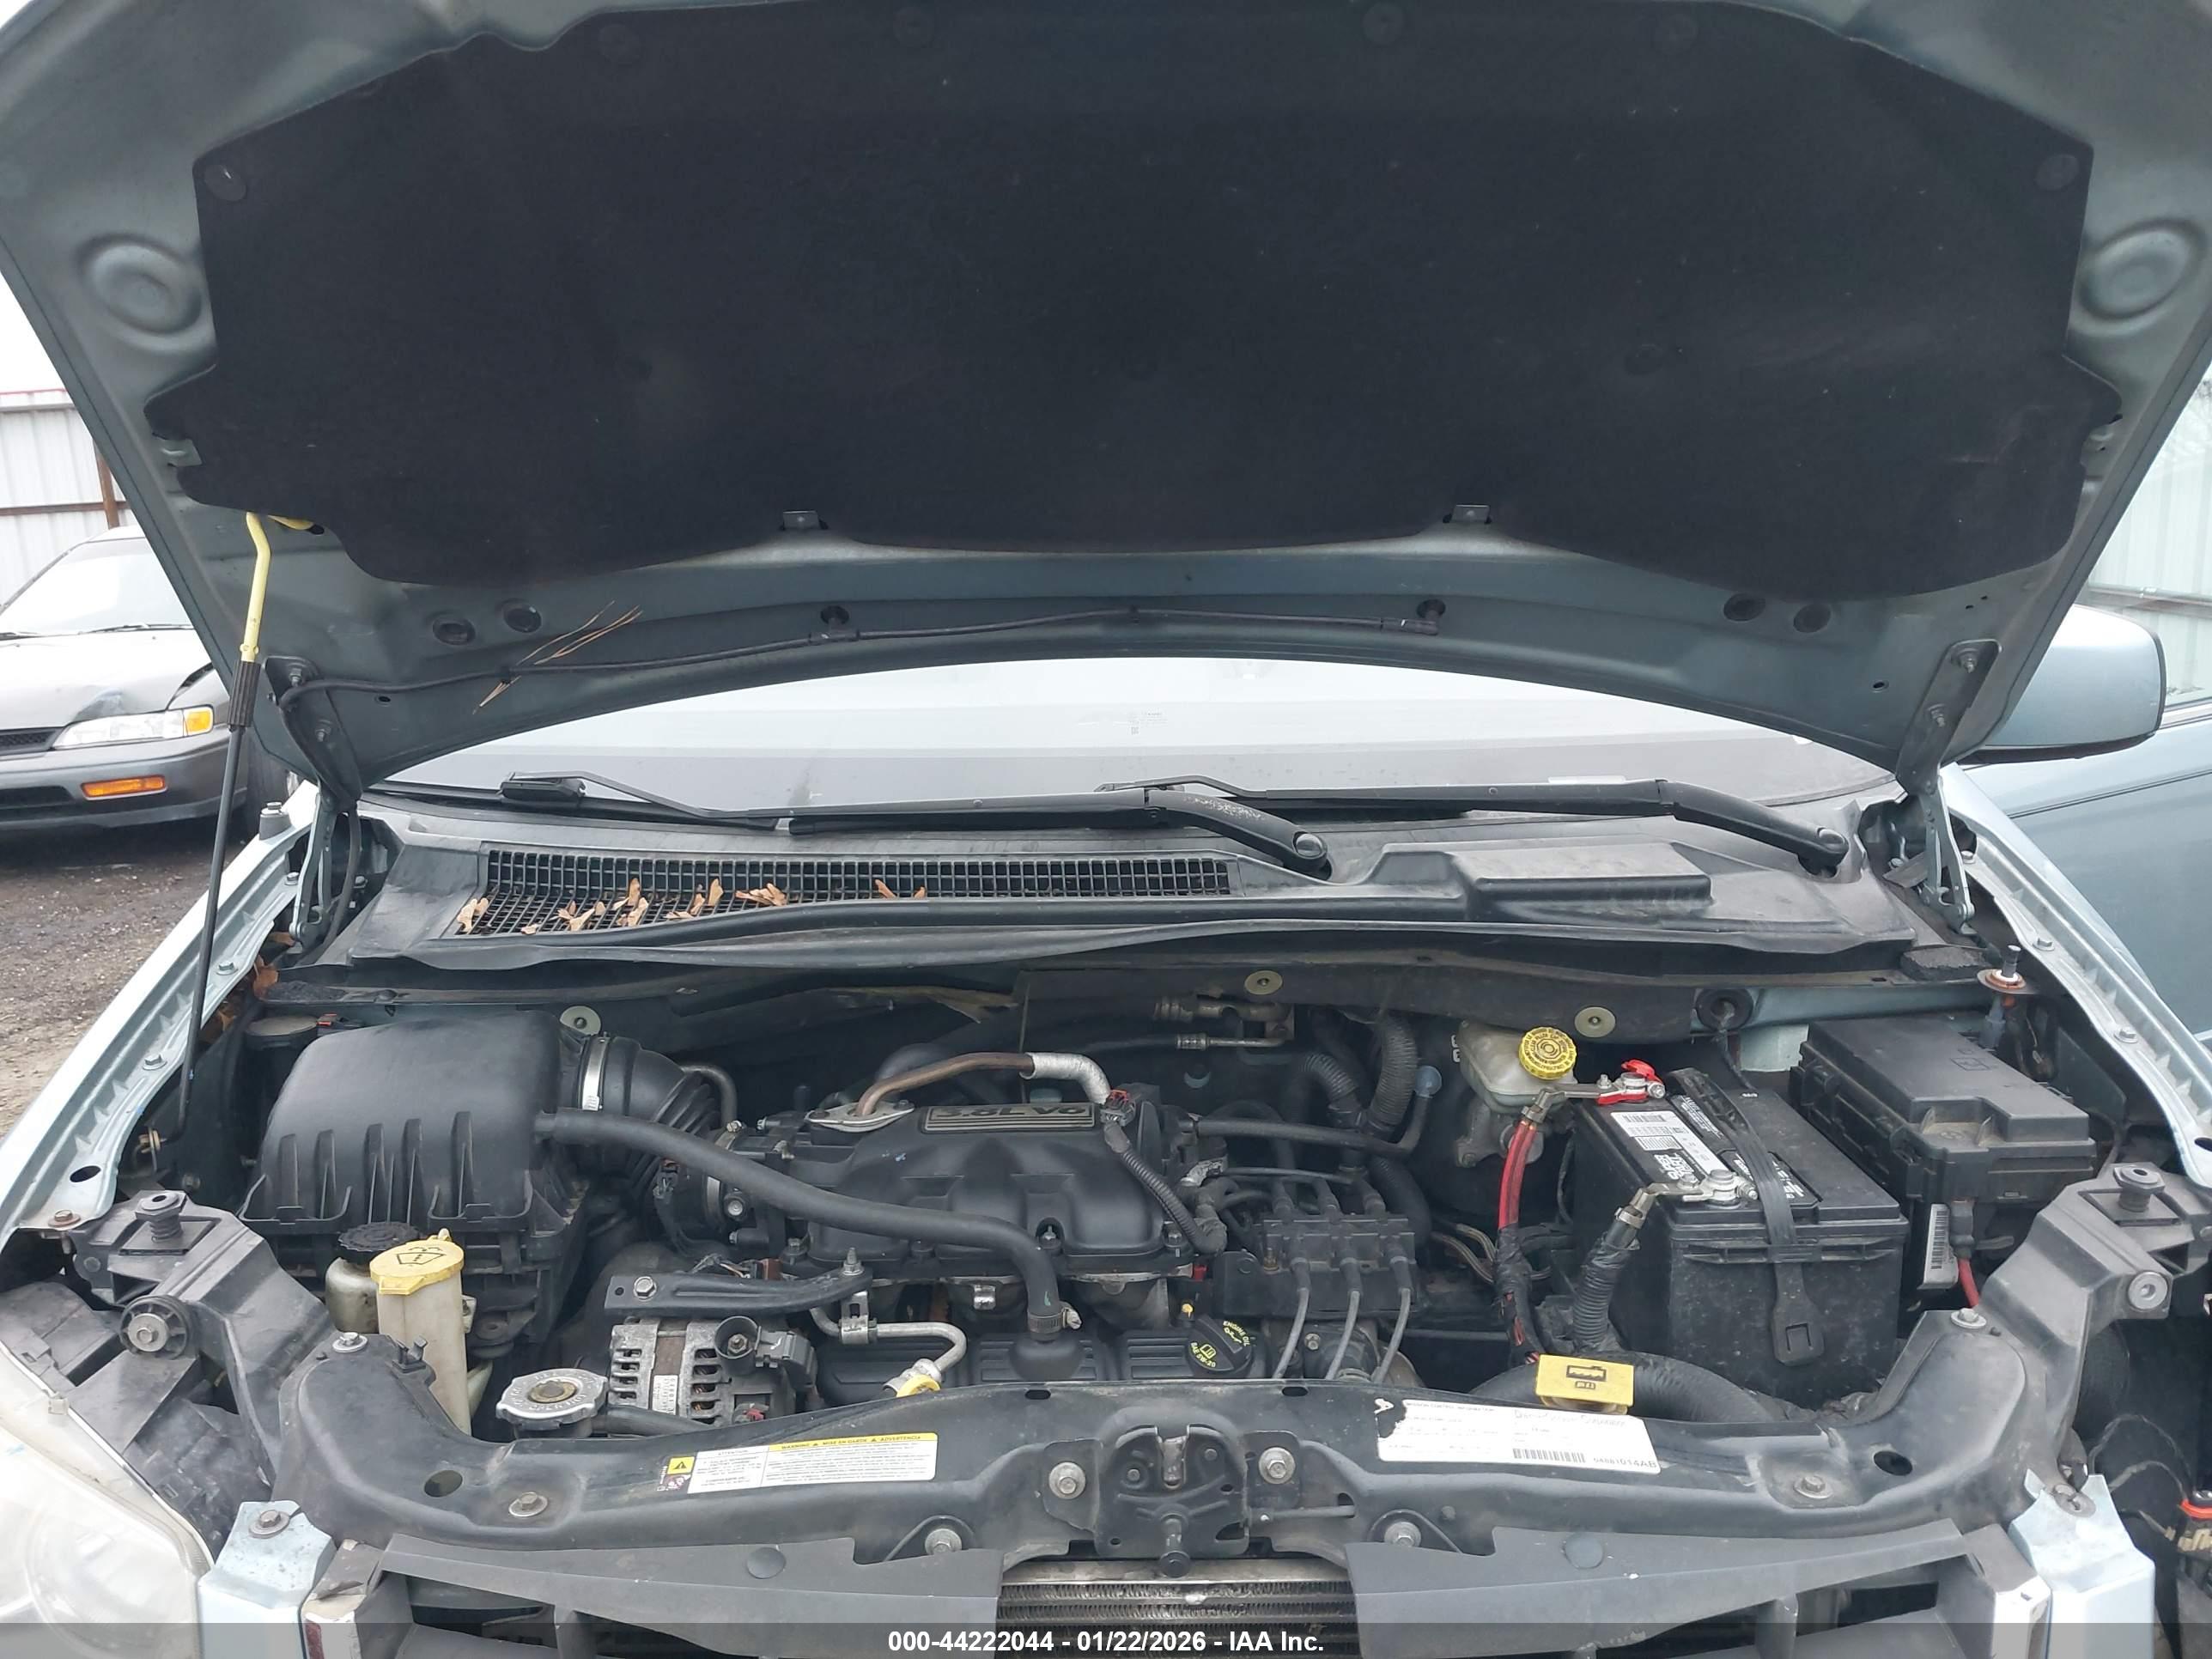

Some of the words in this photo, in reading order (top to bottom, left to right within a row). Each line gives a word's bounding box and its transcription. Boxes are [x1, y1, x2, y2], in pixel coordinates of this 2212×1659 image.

[1031, 1105, 1086, 1115] V6
[1223, 1321, 1246, 1336] ENGINE
[1242, 1335, 1251, 1346] OIL
[1190, 1342, 1200, 1354] SAE
[1195, 1352, 1217, 1368] 5W-20
